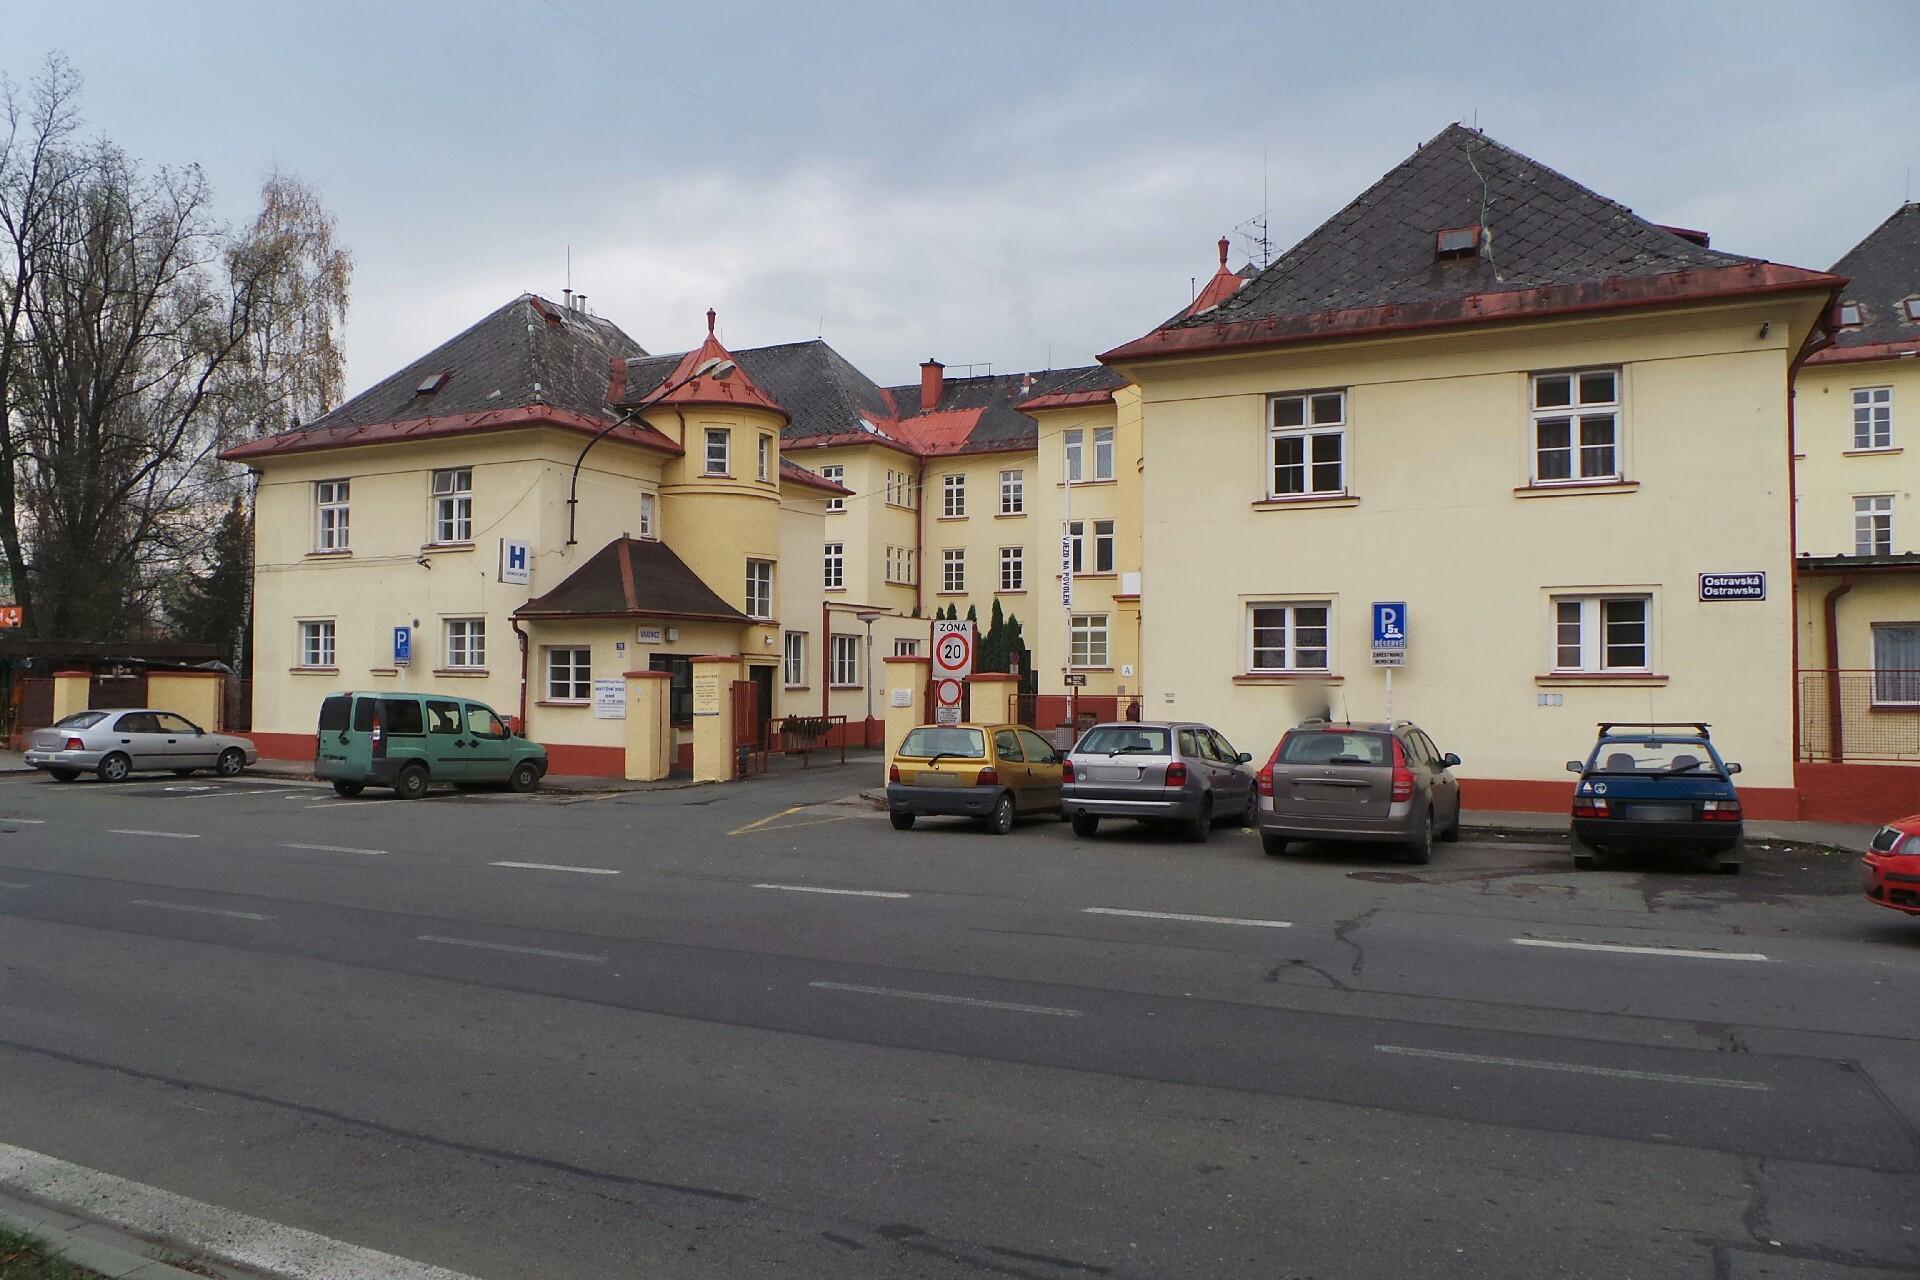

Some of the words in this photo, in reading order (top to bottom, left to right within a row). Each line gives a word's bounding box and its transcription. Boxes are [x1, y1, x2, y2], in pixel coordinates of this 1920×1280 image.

[510, 545, 525, 569] H
[1063, 561, 1070, 570] NA
[1704, 576, 1760, 586] Ostravská
[1704, 586, 1761, 595] Ostrawska
[1381, 608, 1397, 633] P
[940, 621, 967, 632] ZÓNA
[1387, 624, 1399, 633] 5x
[397, 631, 407, 649] P
[945, 645, 961, 659] 20
[1124, 666, 1131, 674] A
